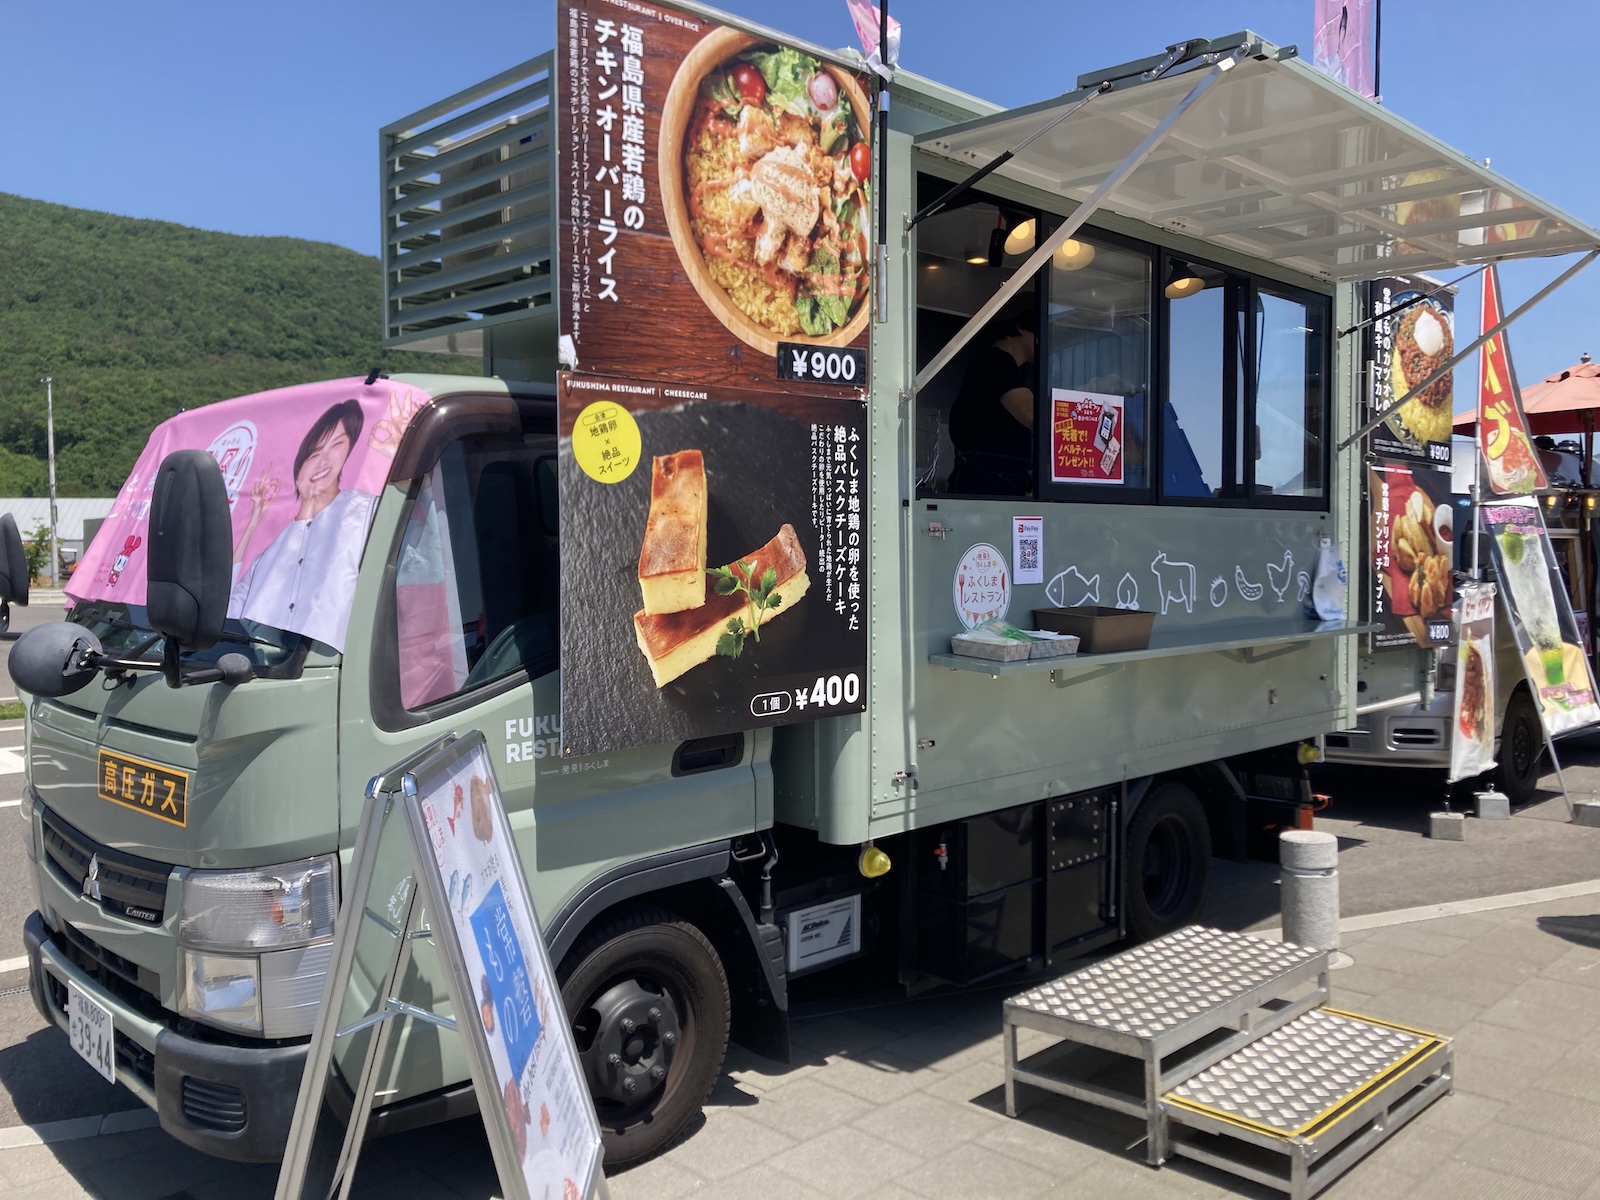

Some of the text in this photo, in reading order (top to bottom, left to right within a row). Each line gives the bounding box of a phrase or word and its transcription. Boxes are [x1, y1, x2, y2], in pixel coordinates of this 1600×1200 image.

[664, 14, 684, 27] OVER
[683, 21, 699, 32] RICE
[620, 23, 645, 230] 福島県産若鶏の
[594, 18, 620, 302] チキンオーバーライス
[791, 350, 856, 380] ¥900
[566, 380, 708, 400] FUKUSHIMA RESTAURANT CHEESECAKE
[589, 420, 618, 437] 地鶏卵
[1062, 428, 1088, 443] 先着で!
[601, 447, 621, 461] 絶品
[1058, 444, 1093, 456] ノベルティー
[1430, 444, 1450, 461] ¥900
[598, 456, 630, 475] スイーツ
[1058, 455, 1095, 468] プレゼント!!
[810, 423, 818, 529] 絶品バスクチーズケーキです。
[834, 425, 847, 615] 絶品バスクチーズケーキ
[848, 427, 860, 630] ふくしま地鶏の卵を使った
[967, 575, 998, 588] ふくしま
[963, 591, 1002, 604] レストラン
[1430, 625, 1450, 640] ¥800
[762, 673, 860, 711] 1個 ¥400
[104, 759, 178, 816] 高圧ガス
[482, 926, 518, 1045] もの
[78, 1016, 111, 1076] 39-44
